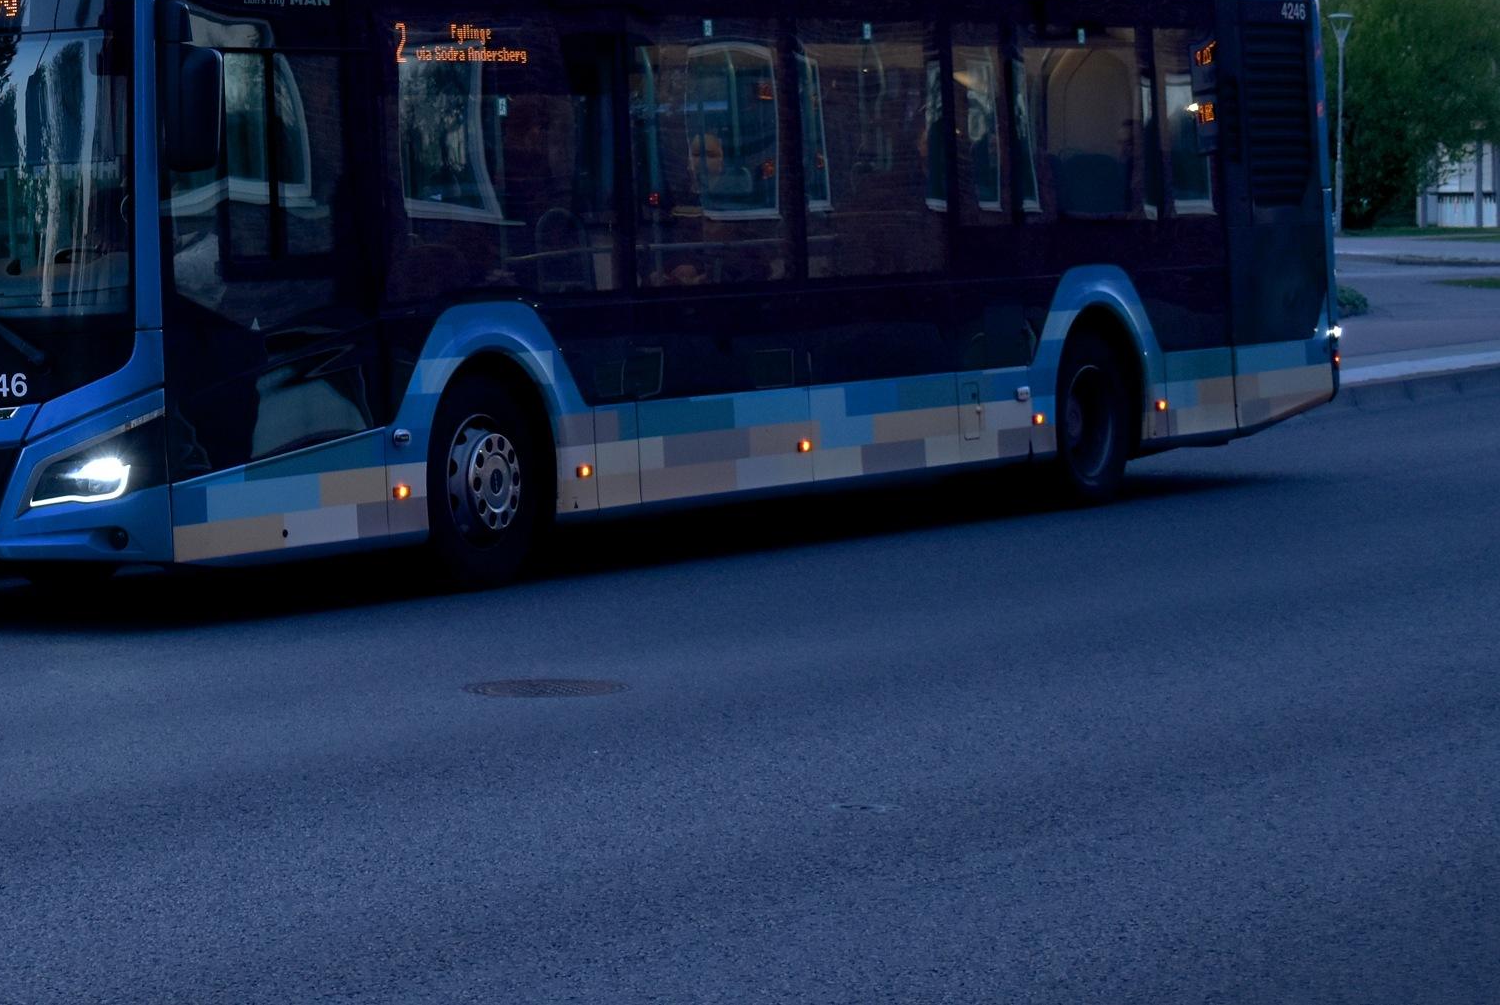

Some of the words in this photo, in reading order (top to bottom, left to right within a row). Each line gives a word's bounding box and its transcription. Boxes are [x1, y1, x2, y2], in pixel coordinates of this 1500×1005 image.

[1281, 2, 1307, 21] 4246
[395, 22, 408, 63] 2
[450, 24, 492, 45] Fyllinge
[416, 45, 432, 61] via
[434, 45, 466, 61] Södra
[467, 46, 528, 64] Andersberg
